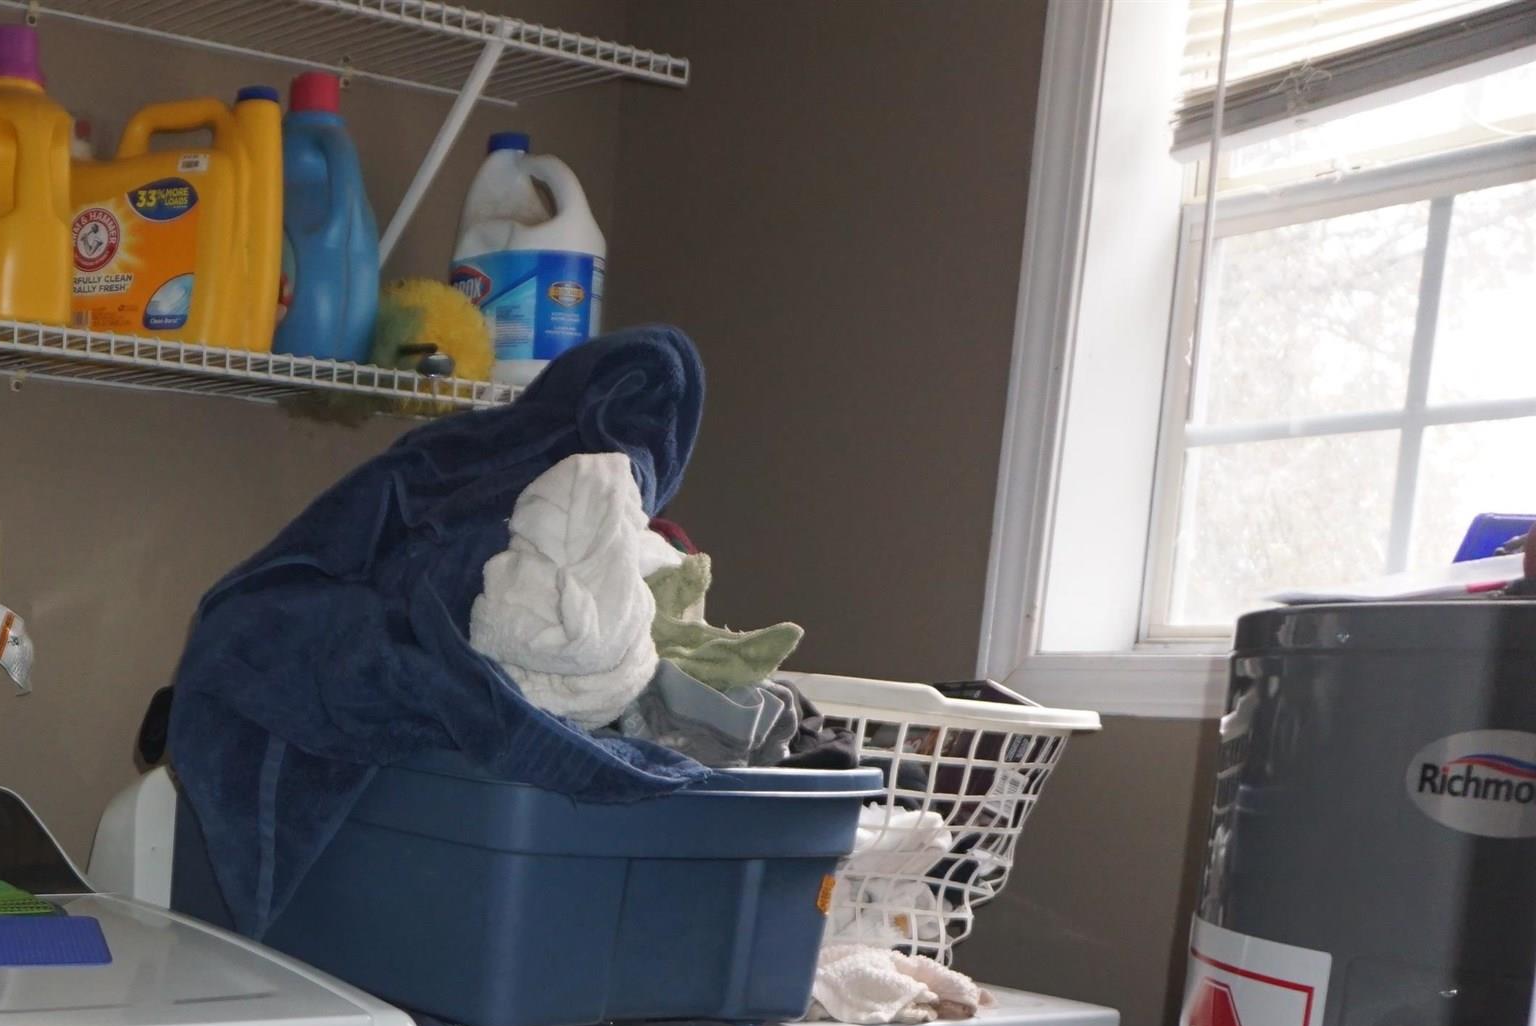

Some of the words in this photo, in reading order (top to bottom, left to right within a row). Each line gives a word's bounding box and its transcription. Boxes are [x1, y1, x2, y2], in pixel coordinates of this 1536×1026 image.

[104, 274, 132, 283] CLEAN
[99, 284, 126, 292] FRESH
[1418, 762, 1536, 804] Richmo
